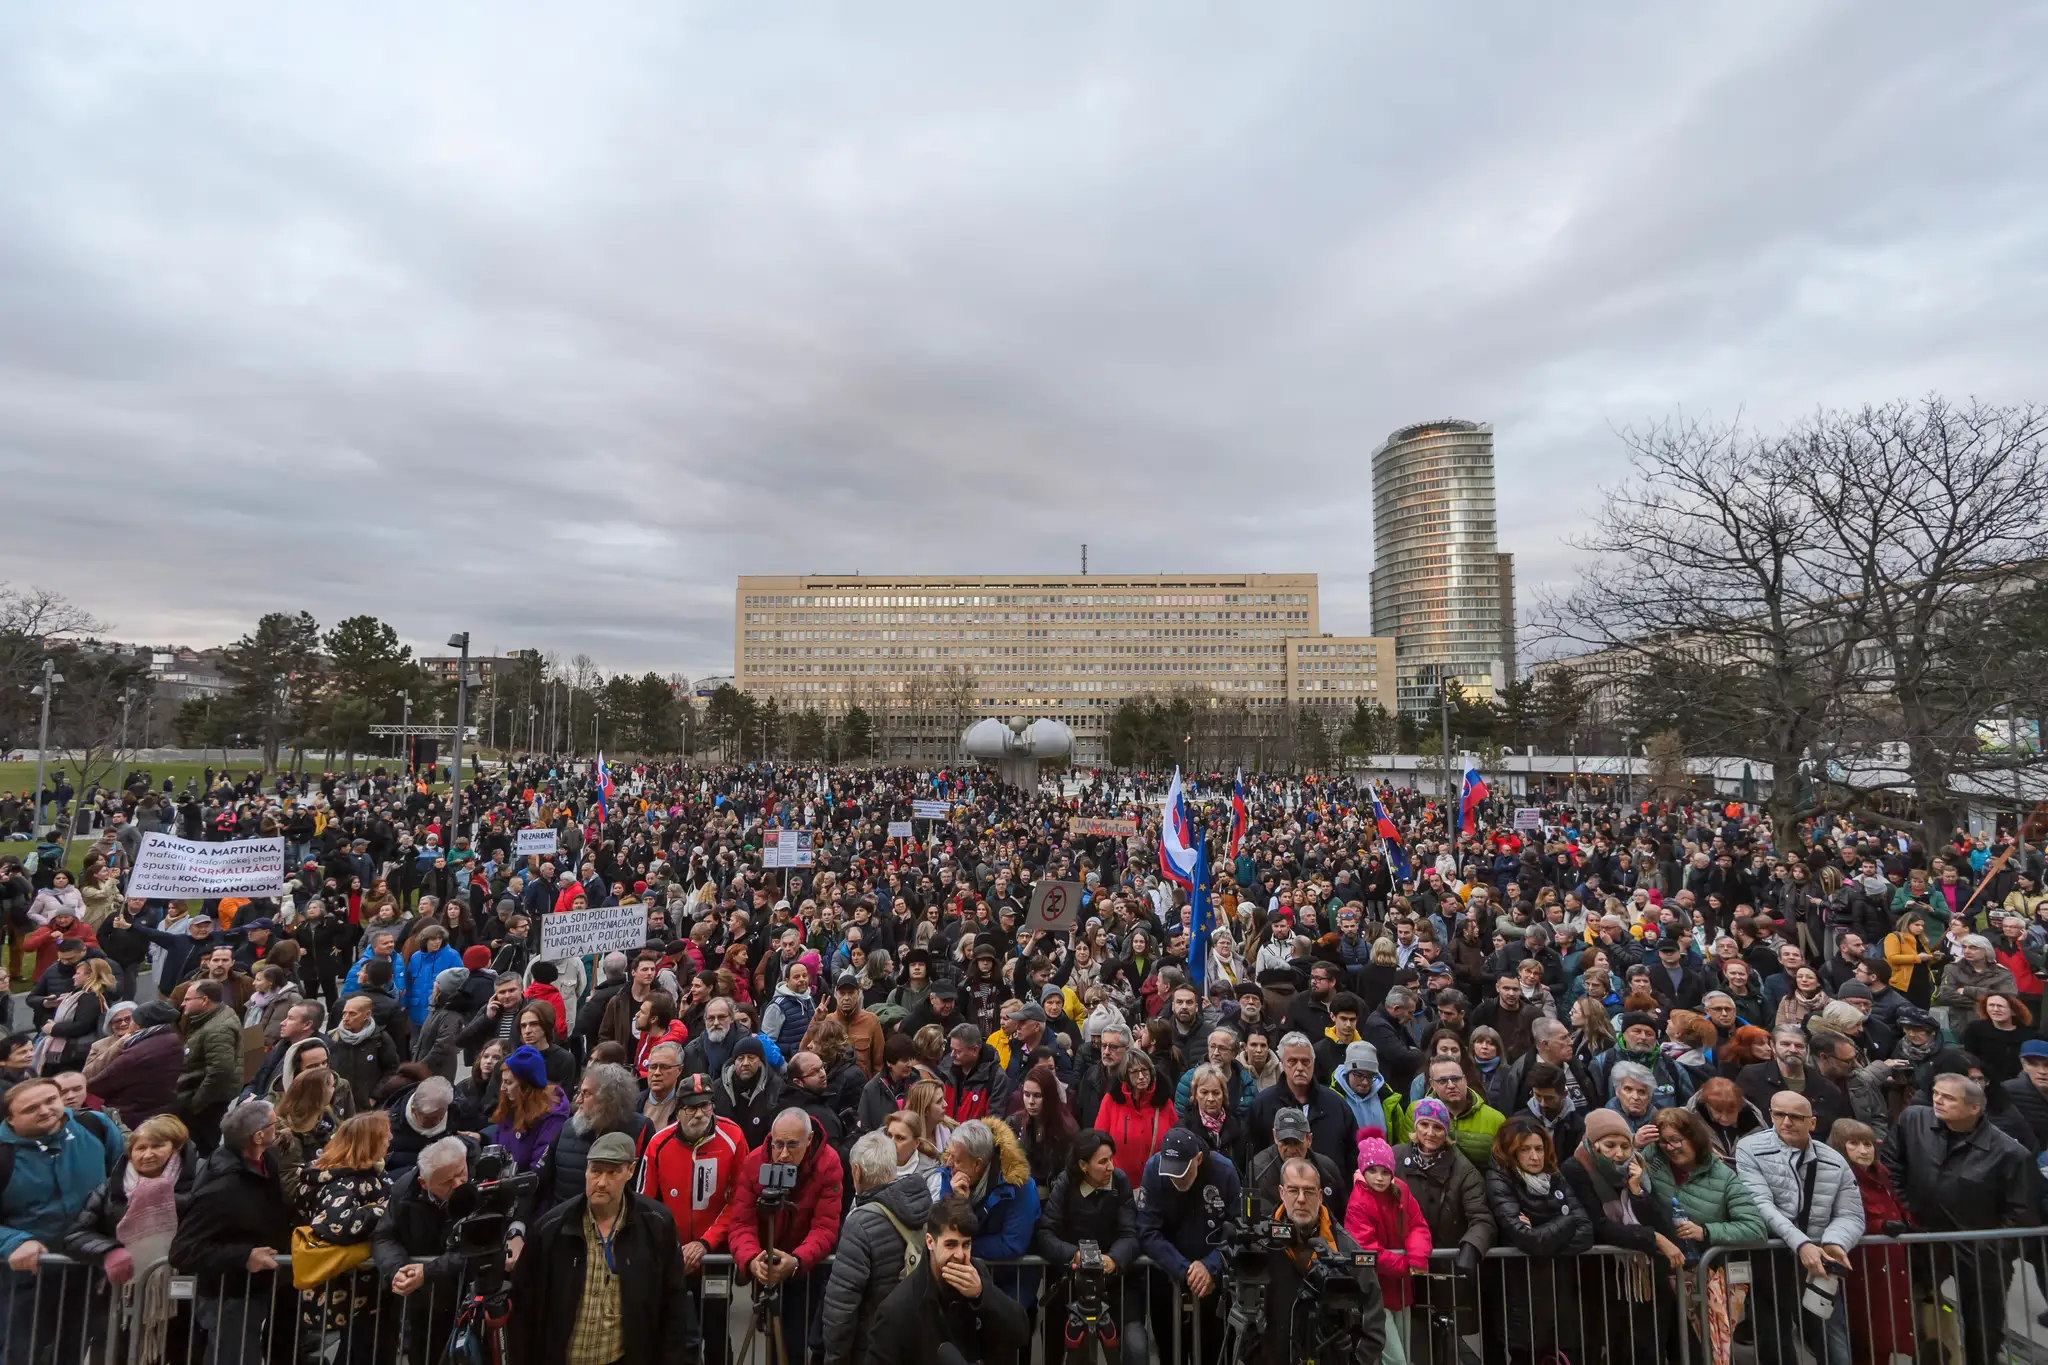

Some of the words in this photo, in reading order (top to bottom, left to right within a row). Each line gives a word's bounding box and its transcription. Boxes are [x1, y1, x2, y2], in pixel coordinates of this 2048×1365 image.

[149, 839, 196, 854] JANKO
[198, 848, 208, 856] A
[211, 844, 281, 856] MARTINKA,
[253, 855, 281, 864] chaty
[142, 862, 186, 871] spustili
[188, 864, 282, 876] NORMALIZÁCIU
[178, 874, 242, 884] KOČNEROVÝM
[136, 882, 199, 893] súdruhom
[202, 884, 281, 894] HRANOLOM.
[556, 915, 568, 925] JA
[570, 912, 587, 923] SOM
[620, 907, 633, 917] NA
[627, 916, 644, 927] AKO
[630, 928, 641, 938] ZA
[587, 945, 594, 954] A
